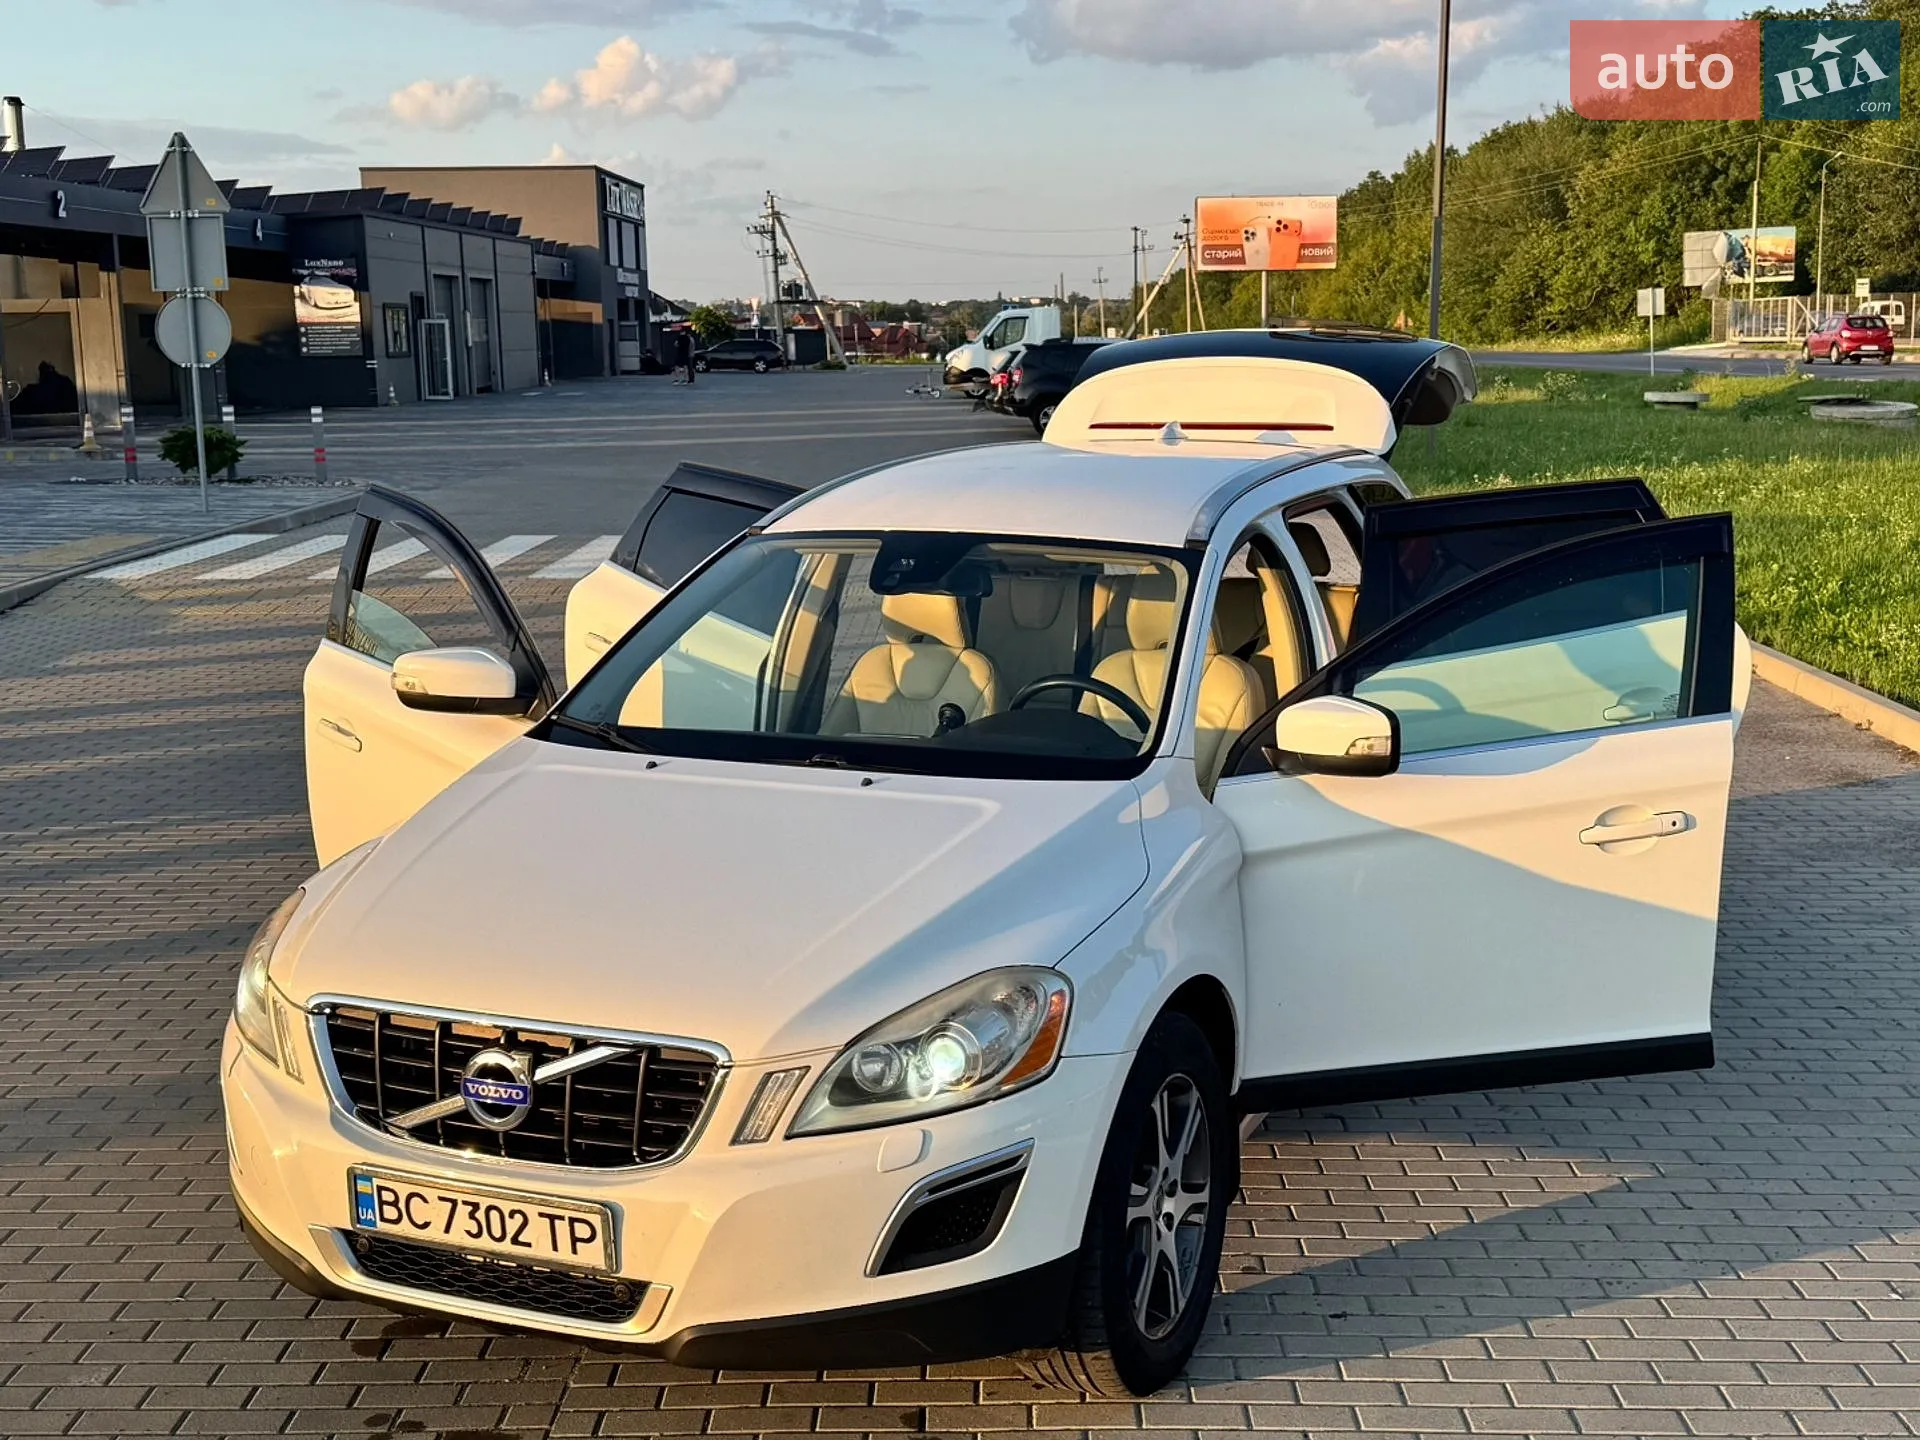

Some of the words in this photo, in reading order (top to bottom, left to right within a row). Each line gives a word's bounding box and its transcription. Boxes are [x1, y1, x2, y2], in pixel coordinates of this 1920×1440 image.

[57, 190, 67, 218] 2
[1204, 249, 1243, 259] старий
[1301, 245, 1335, 257] новий
[465, 1082, 524, 1100] VOLVO
[358, 1206, 376, 1222] UA
[376, 1184, 432, 1231] BC
[437, 1195, 533, 1249] 7302
[538, 1211, 598, 1255] TP
